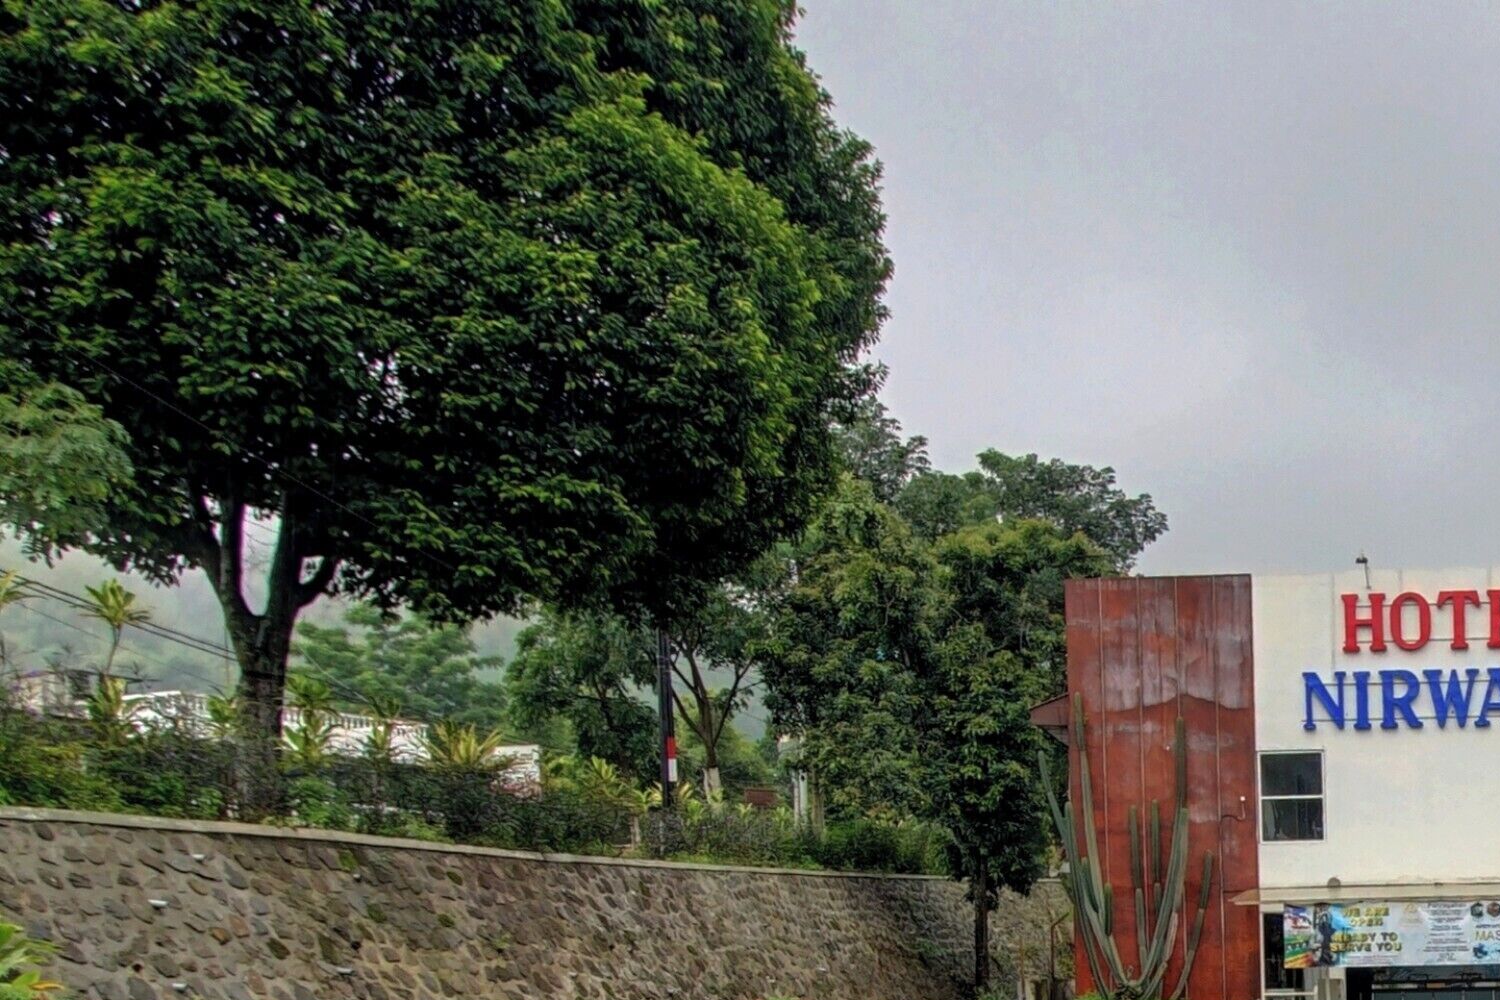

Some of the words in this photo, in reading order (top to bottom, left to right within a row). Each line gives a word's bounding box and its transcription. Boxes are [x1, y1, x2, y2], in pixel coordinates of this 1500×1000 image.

[1331, 932, 1376, 943] READY
[1380, 931, 1398, 942] TO
[1330, 942, 1372, 952] SERVE
[1376, 942, 1402, 952] YOU
